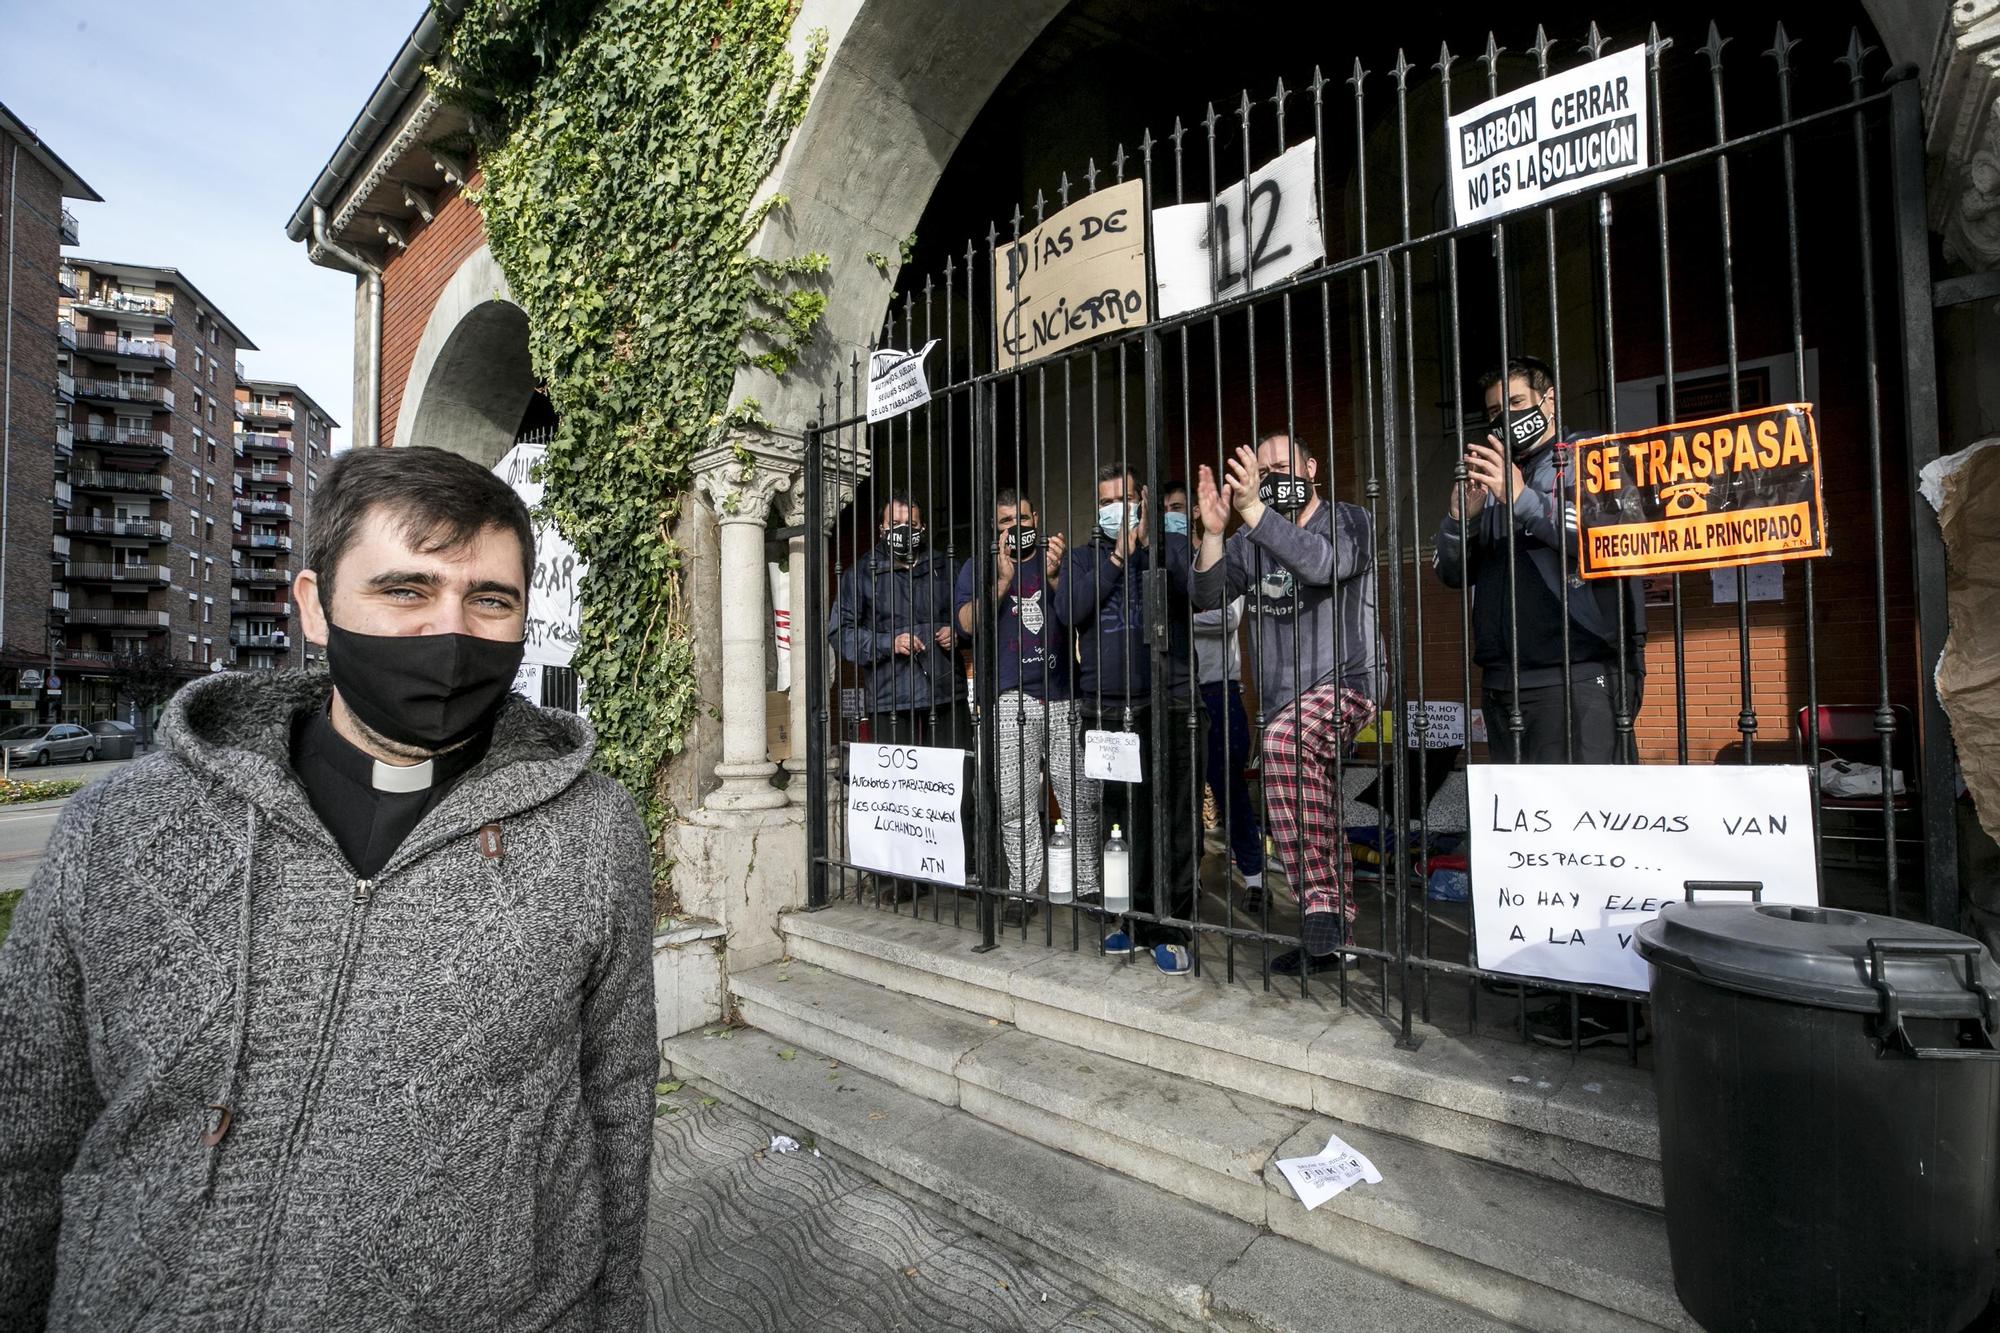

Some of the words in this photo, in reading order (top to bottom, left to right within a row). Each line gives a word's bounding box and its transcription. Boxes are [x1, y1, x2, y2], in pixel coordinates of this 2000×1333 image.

[1463, 105, 1534, 165] BARBÓN
[1551, 76, 1629, 130] CERRAR
[1468, 173, 1488, 210] NO
[1492, 162, 1511, 199] ES
[1517, 155, 1538, 190] LA
[1541, 120, 1634, 183] SOLUCIÓN
[1080, 208, 1127, 241] DE
[1513, 414, 1545, 439] SOS
[1586, 446, 1622, 494] SE
[1629, 416, 1809, 487] TRASPASA
[1595, 529, 1678, 559] PREGUNTAR
[1684, 526, 1702, 551] AL
[1706, 513, 1802, 549] PRINCIPADO
[1407, 714, 1456, 722] OCPAMOS
[1439, 705, 1459, 713] HOY
[1410, 739, 1450, 748] BRBÓN
[877, 746, 918, 770] SOS
[852, 799, 869, 812] LES
[912, 807, 924, 819] SE
[1493, 794, 1552, 833] LAS
[1573, 810, 1690, 833] AYUDAS
[1722, 814, 1787, 836] VAN
[920, 857, 946, 874] ATN
[1499, 887, 1525, 908] NO
[1537, 891, 1580, 909] HAY
[1509, 924, 1526, 942] A
[1549, 927, 1586, 946] LA
